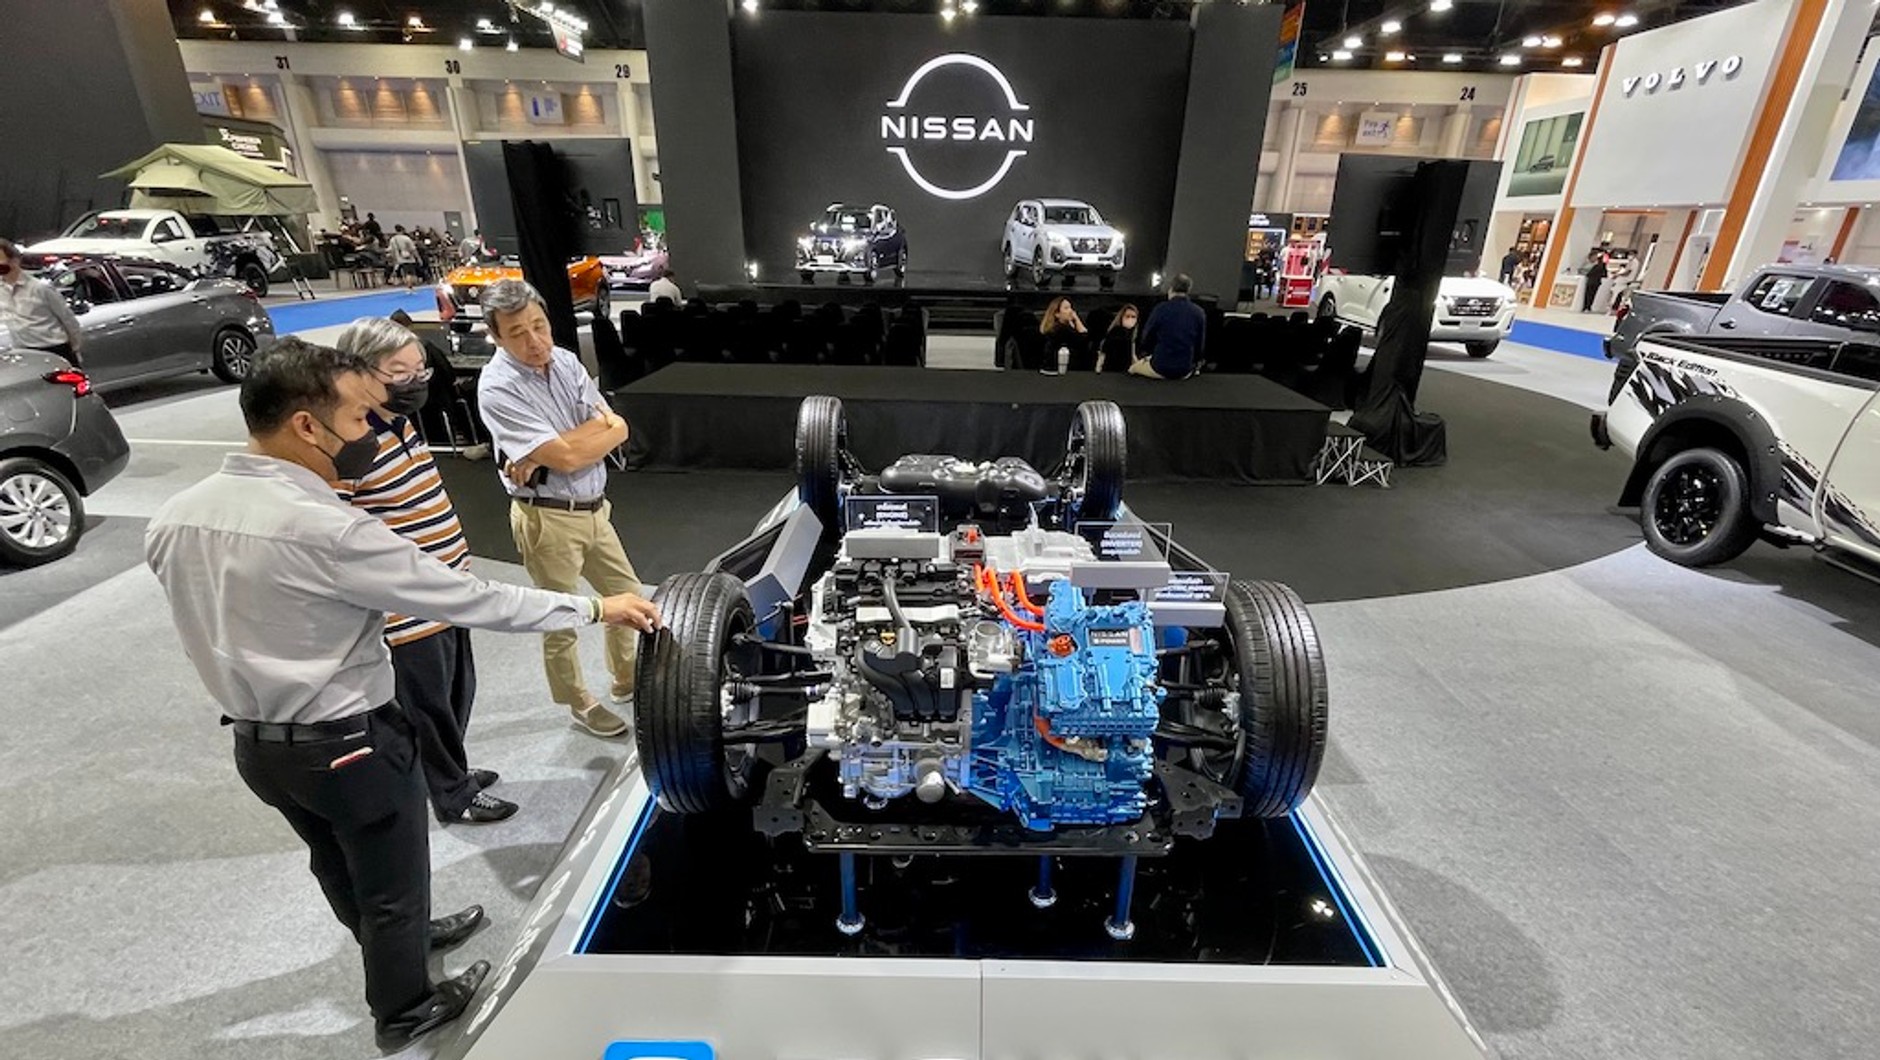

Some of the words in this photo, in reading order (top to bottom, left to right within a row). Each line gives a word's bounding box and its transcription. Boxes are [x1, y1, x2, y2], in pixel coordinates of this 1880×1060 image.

[275, 56, 290, 69] 31
[444, 60, 461, 74] 30
[615, 64, 631, 78] 29
[1622, 56, 1742, 96] VOLVO
[1292, 82, 1308, 96] 25
[1460, 86, 1476, 101] 24
[881, 115, 1034, 142] NISSAN
[1677, 359, 1718, 376] Edition
